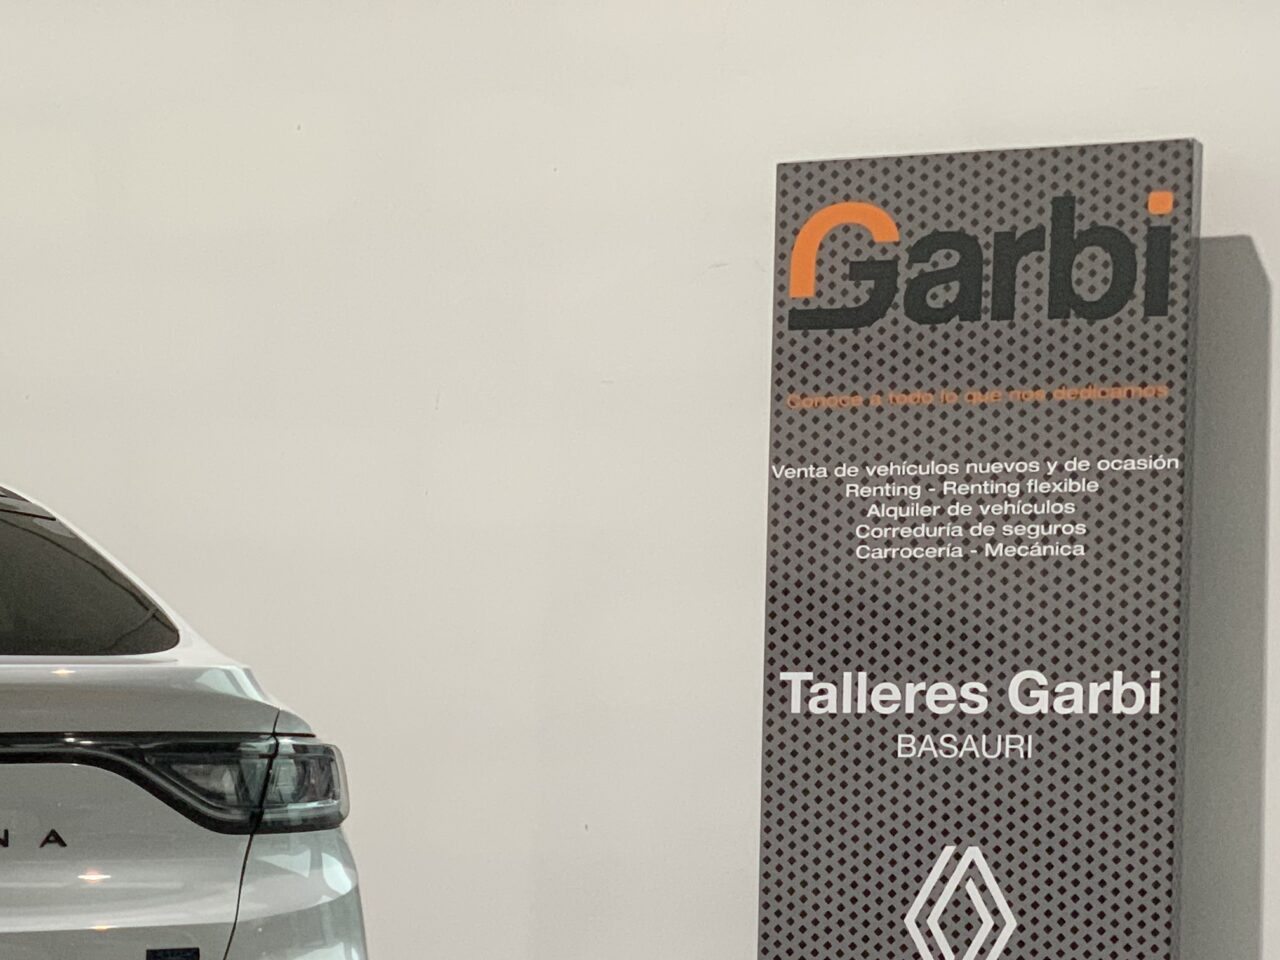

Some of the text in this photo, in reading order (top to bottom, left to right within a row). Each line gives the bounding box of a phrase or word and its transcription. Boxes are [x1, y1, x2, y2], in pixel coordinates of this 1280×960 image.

[788, 190, 1174, 330] Garbi
[888, 391, 934, 405] todo
[966, 390, 1001, 406] que
[1052, 385, 1169, 399] dedicamos
[772, 454, 1179, 479] Venta de vehículos nuevos y de ocasión
[846, 482, 921, 499] Renting
[943, 479, 1020, 497] Renting
[1026, 478, 1099, 494] flexible
[867, 500, 1075, 520] Alquiler de vehículos
[855, 522, 1087, 539] Correduría de seguros
[855, 543, 963, 559] Carrocería
[985, 542, 1085, 557] Mecánica
[780, 669, 1161, 714] Talleres Garbi
[897, 734, 1033, 759] BASAURI
